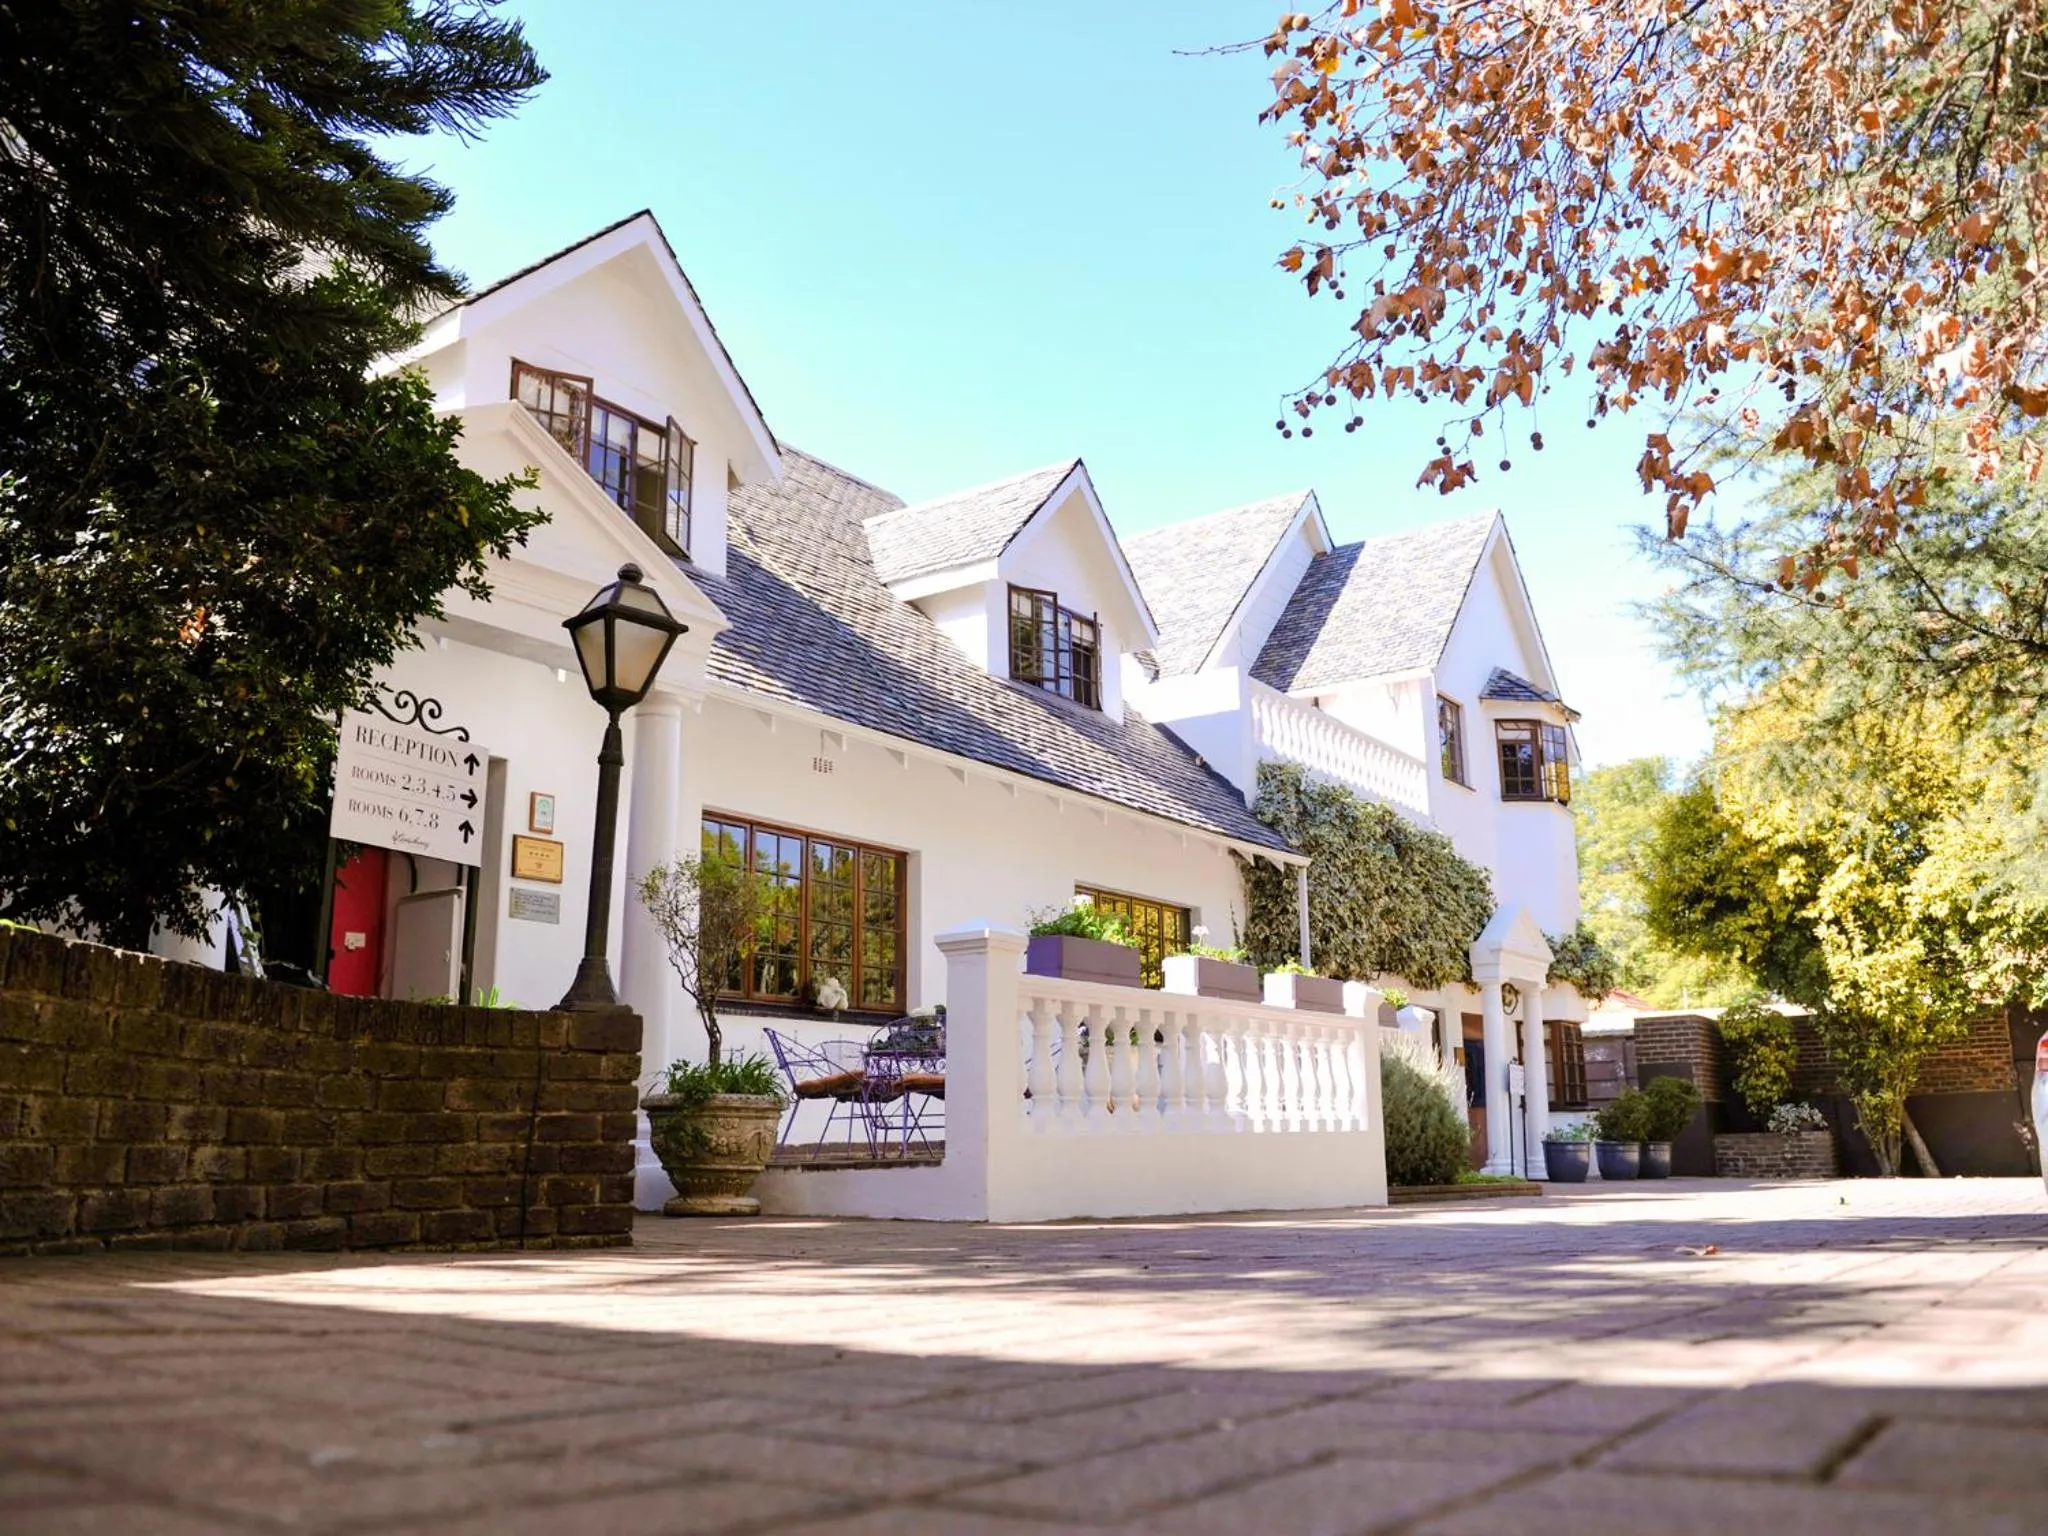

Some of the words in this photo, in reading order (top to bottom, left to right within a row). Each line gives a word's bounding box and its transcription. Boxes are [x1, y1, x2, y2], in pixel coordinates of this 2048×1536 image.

[355, 725, 458, 768] RECEPTION
[351, 766, 397, 786] ROOMS
[348, 799, 394, 819] ROOMS
